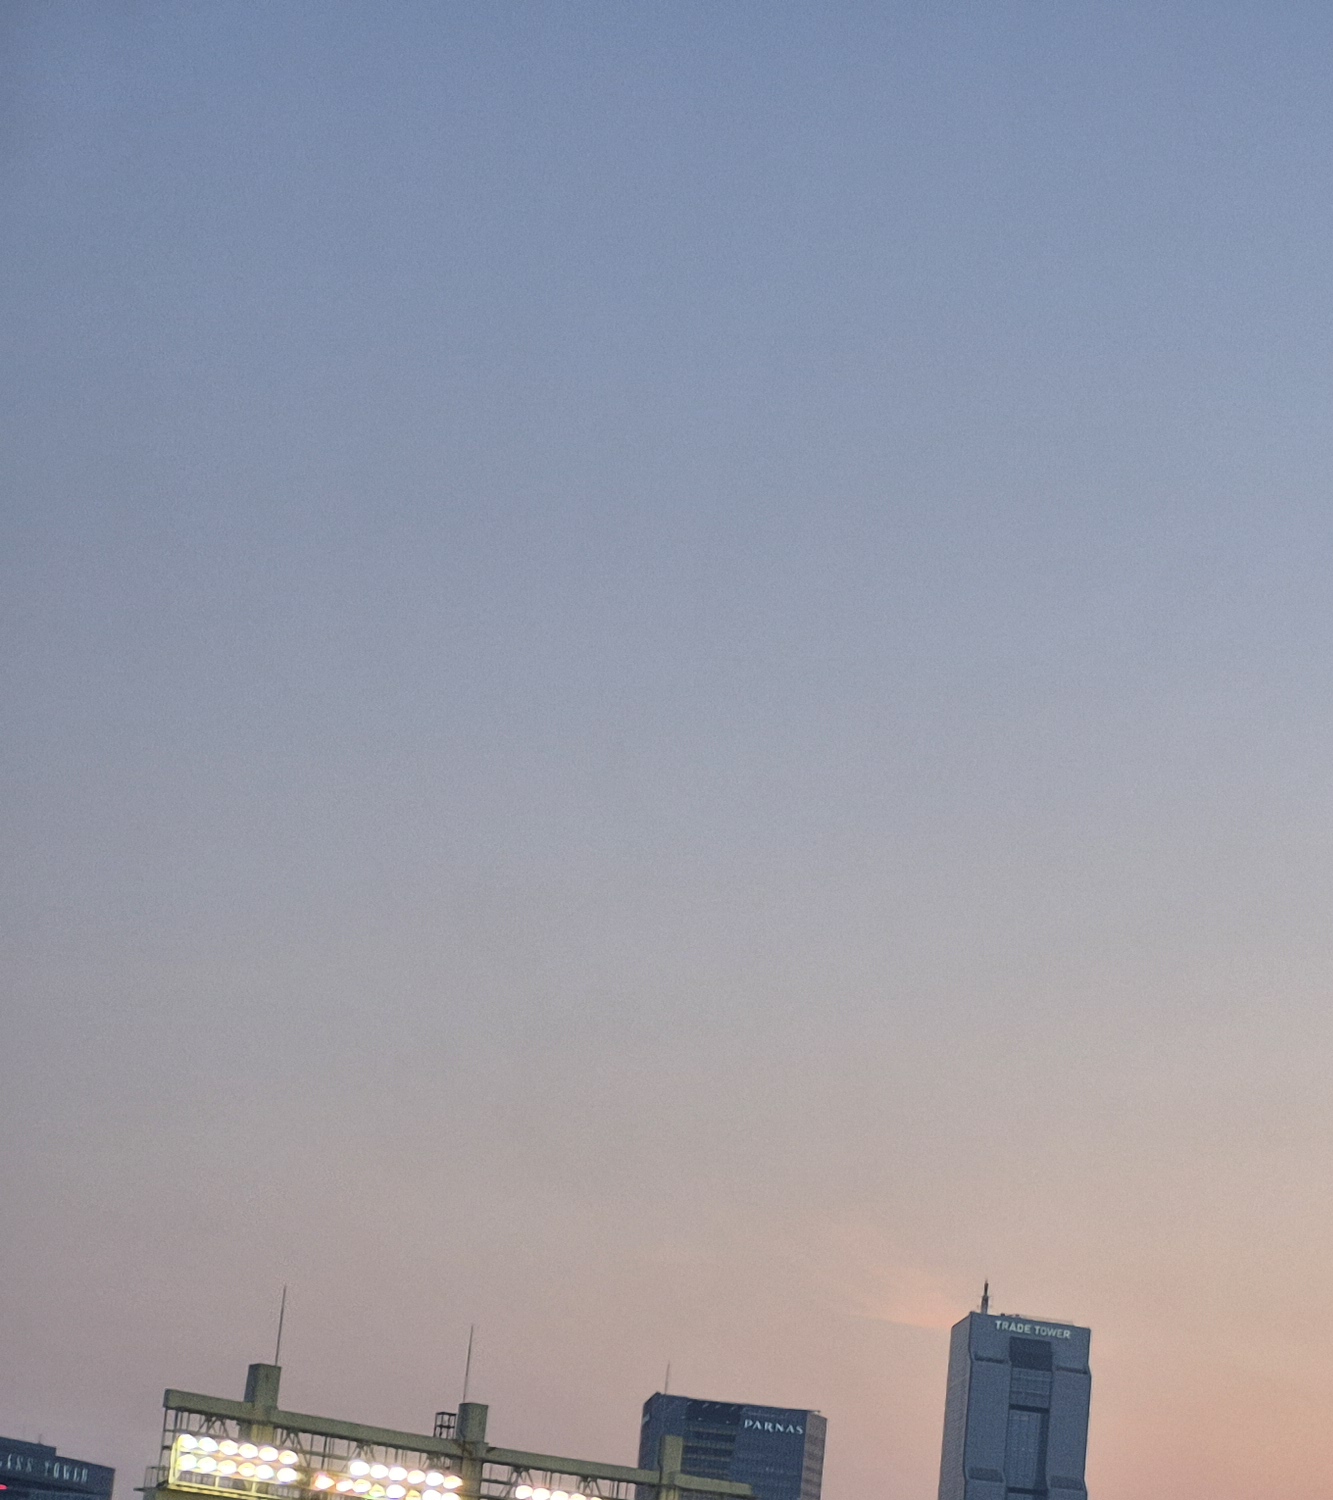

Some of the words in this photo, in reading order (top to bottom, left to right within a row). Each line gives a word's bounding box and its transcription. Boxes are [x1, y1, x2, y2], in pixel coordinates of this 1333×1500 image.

[995, 1319, 1031, 1335] TRADE
[1034, 1325, 1072, 1340] TOWER
[743, 1418, 804, 1436] PARNAS
